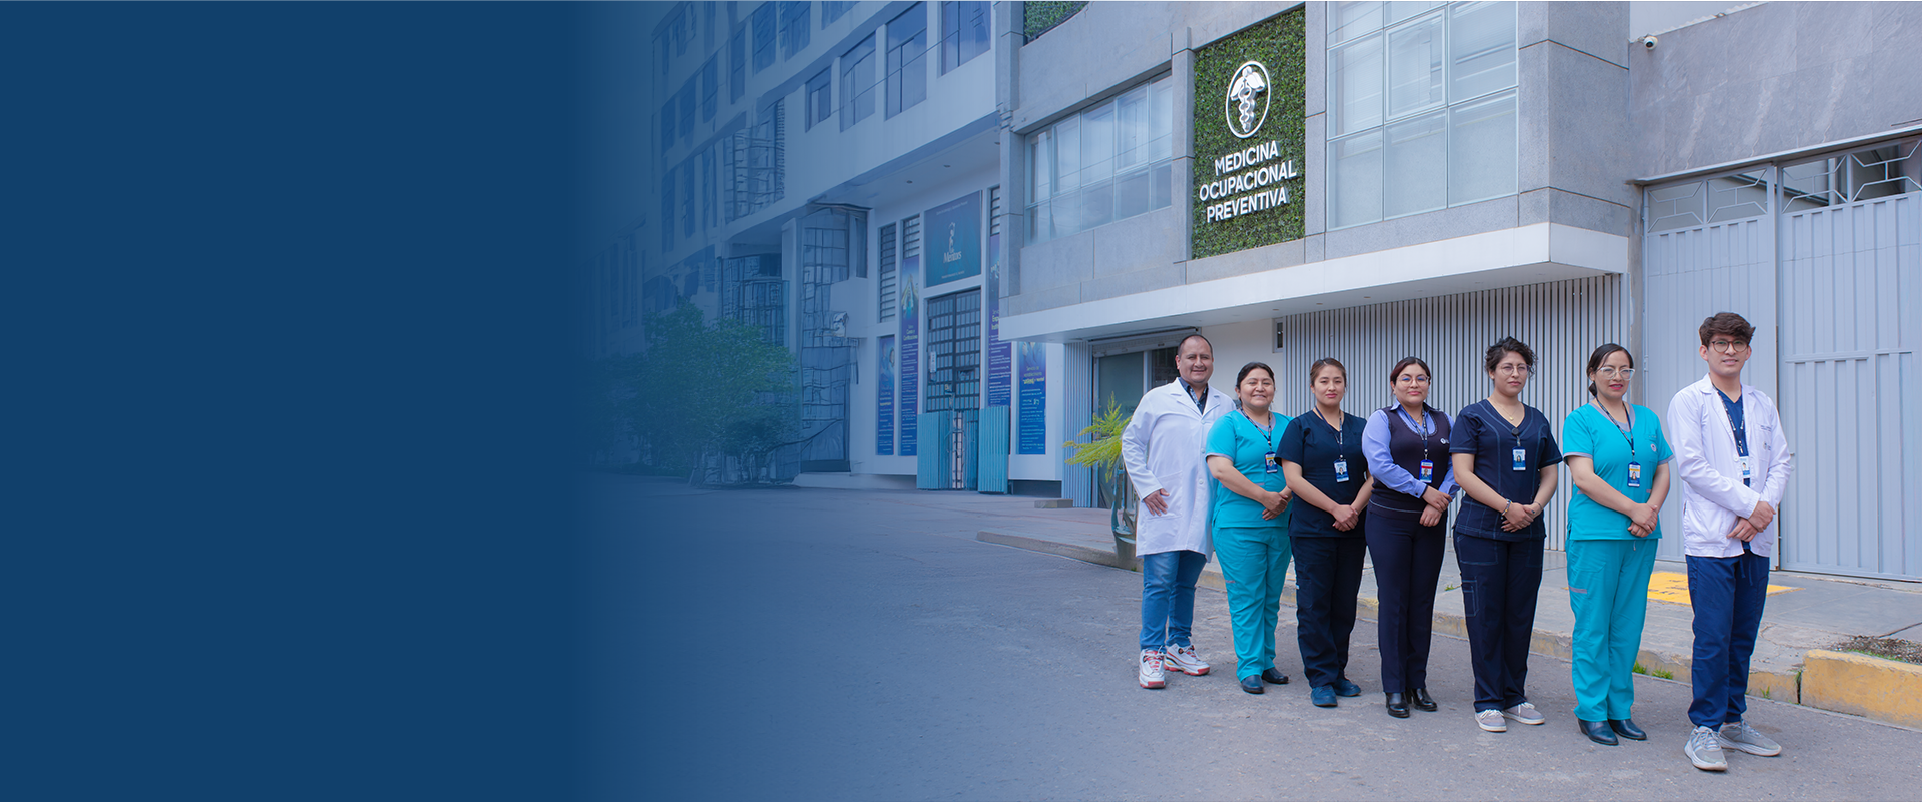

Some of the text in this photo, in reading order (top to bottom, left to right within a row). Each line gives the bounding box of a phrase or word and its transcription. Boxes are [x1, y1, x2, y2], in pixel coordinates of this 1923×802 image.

[1214, 140, 1279, 176] MEDICINA
[1199, 160, 1297, 201] OCUPACIONAL
[1207, 186, 1287, 223] PREVENTIVA
[942, 250, 962, 264] Mentors
